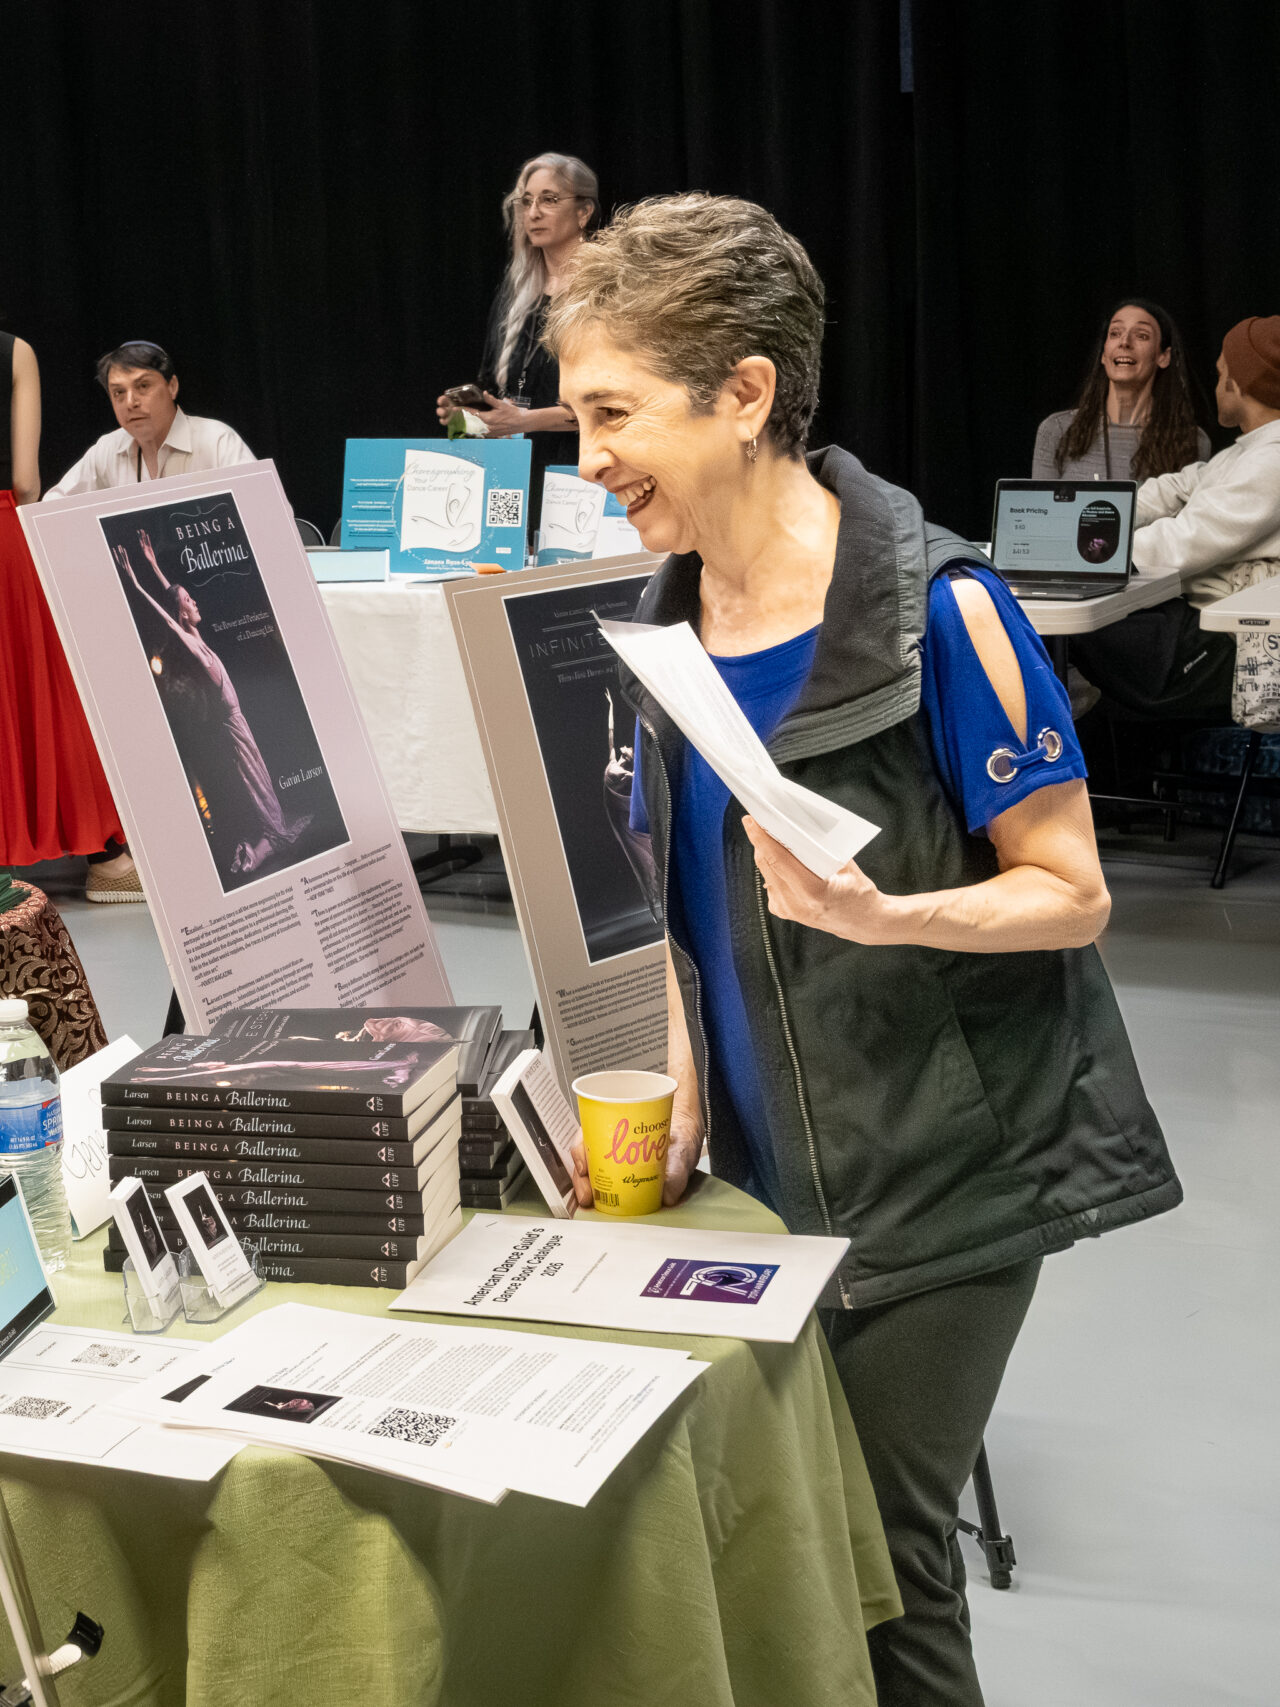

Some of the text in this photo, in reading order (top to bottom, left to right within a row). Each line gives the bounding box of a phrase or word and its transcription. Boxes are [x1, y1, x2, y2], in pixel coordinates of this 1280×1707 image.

[1026, 507, 1049, 516] Pricing
[176, 516, 236, 540] BEING A
[180, 541, 250, 574] Ballerina
[528, 631, 608, 658] INFINITE
[279, 766, 323, 790] Gavin Larsen
[173, 1038, 221, 1061] Ballerina
[124, 1089, 384, 1112] Larsen BEING A Ballerina UPF
[126, 1116, 152, 1126] Larsen
[169, 1118, 213, 1129] BEING
[217, 1121, 224, 1129] A
[229, 1117, 296, 1133] Ballerina
[633, 1118, 670, 1135] choose
[131, 1138, 395, 1162] Larsen BEING A Ballerina UPF
[604, 1118, 667, 1165] love
[133, 1167, 160, 1177] Larsen
[225, 1171, 233, 1180] A
[238, 1167, 305, 1184] Ballerina
[391, 1172, 400, 1187] UPF
[146, 1189, 404, 1209] rsen A Ballerina UPF
[230, 1213, 406, 1232] A Ballerina UPF
[239, 1236, 399, 1257] Ballerina UPF
[380, 1266, 388, 1282] UPF
[463, 1273, 504, 1306] American
[492, 1251, 524, 1273] Dance
[492, 1234, 563, 1303] Dance Book Catalogue
[540, 1262, 564, 1277] 2026
